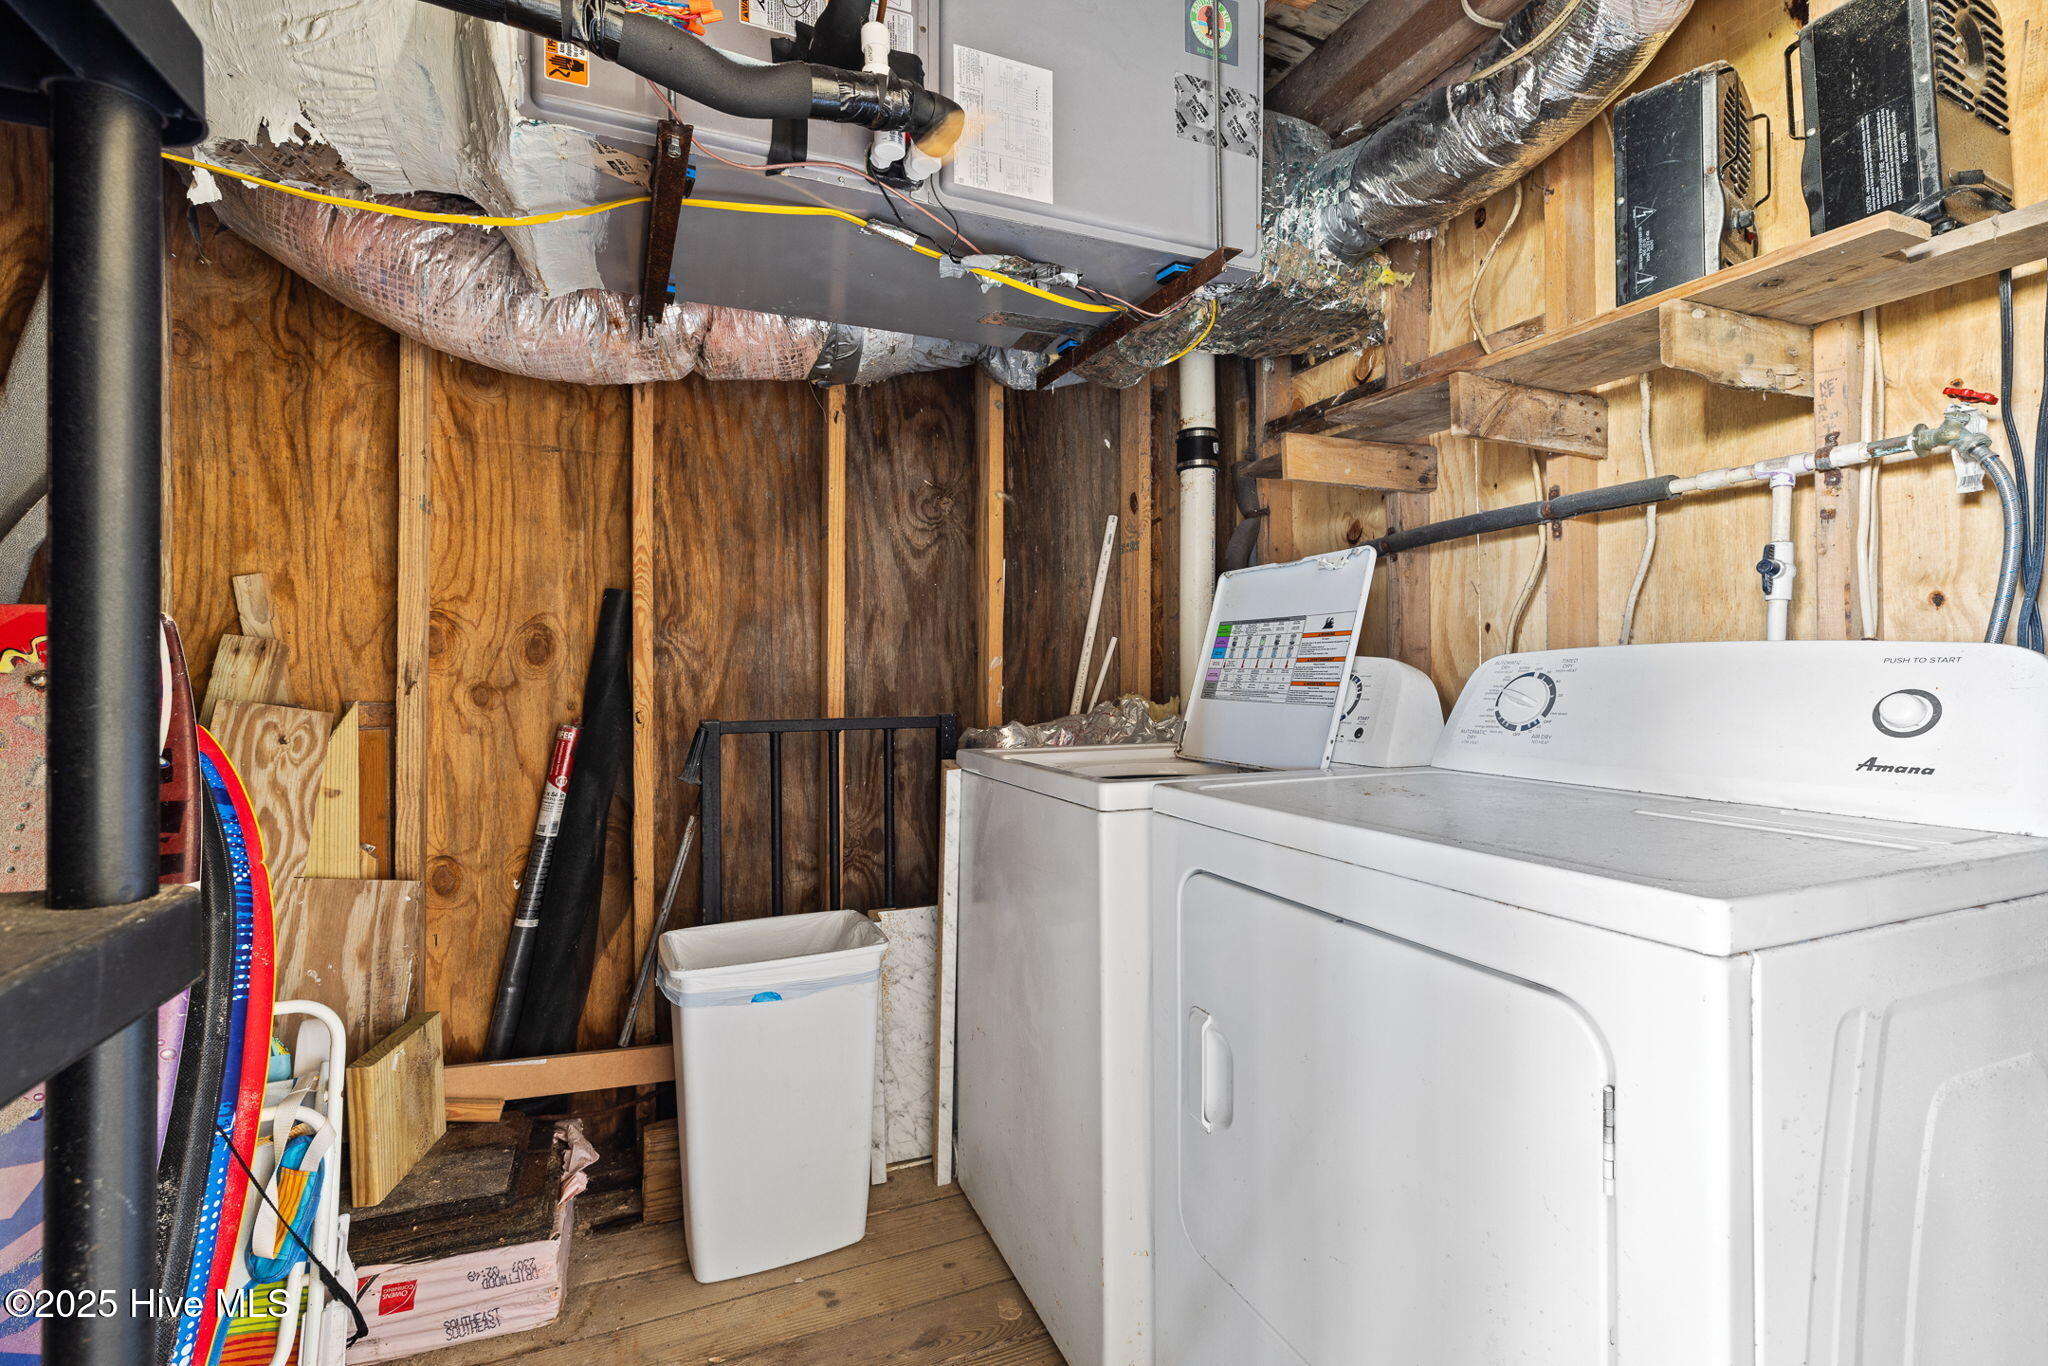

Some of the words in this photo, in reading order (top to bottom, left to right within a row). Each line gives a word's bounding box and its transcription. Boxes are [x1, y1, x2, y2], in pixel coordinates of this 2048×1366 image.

[1929, 656, 1962, 664] START
[1855, 756, 1936, 776] Amana
[482, 1265, 540, 1289] DRIFTWOOD
[382, 1288, 410, 1301] OWENS
[383, 1283, 415, 1294] CORNING
[443, 1307, 501, 1329] SOUTHEAST
